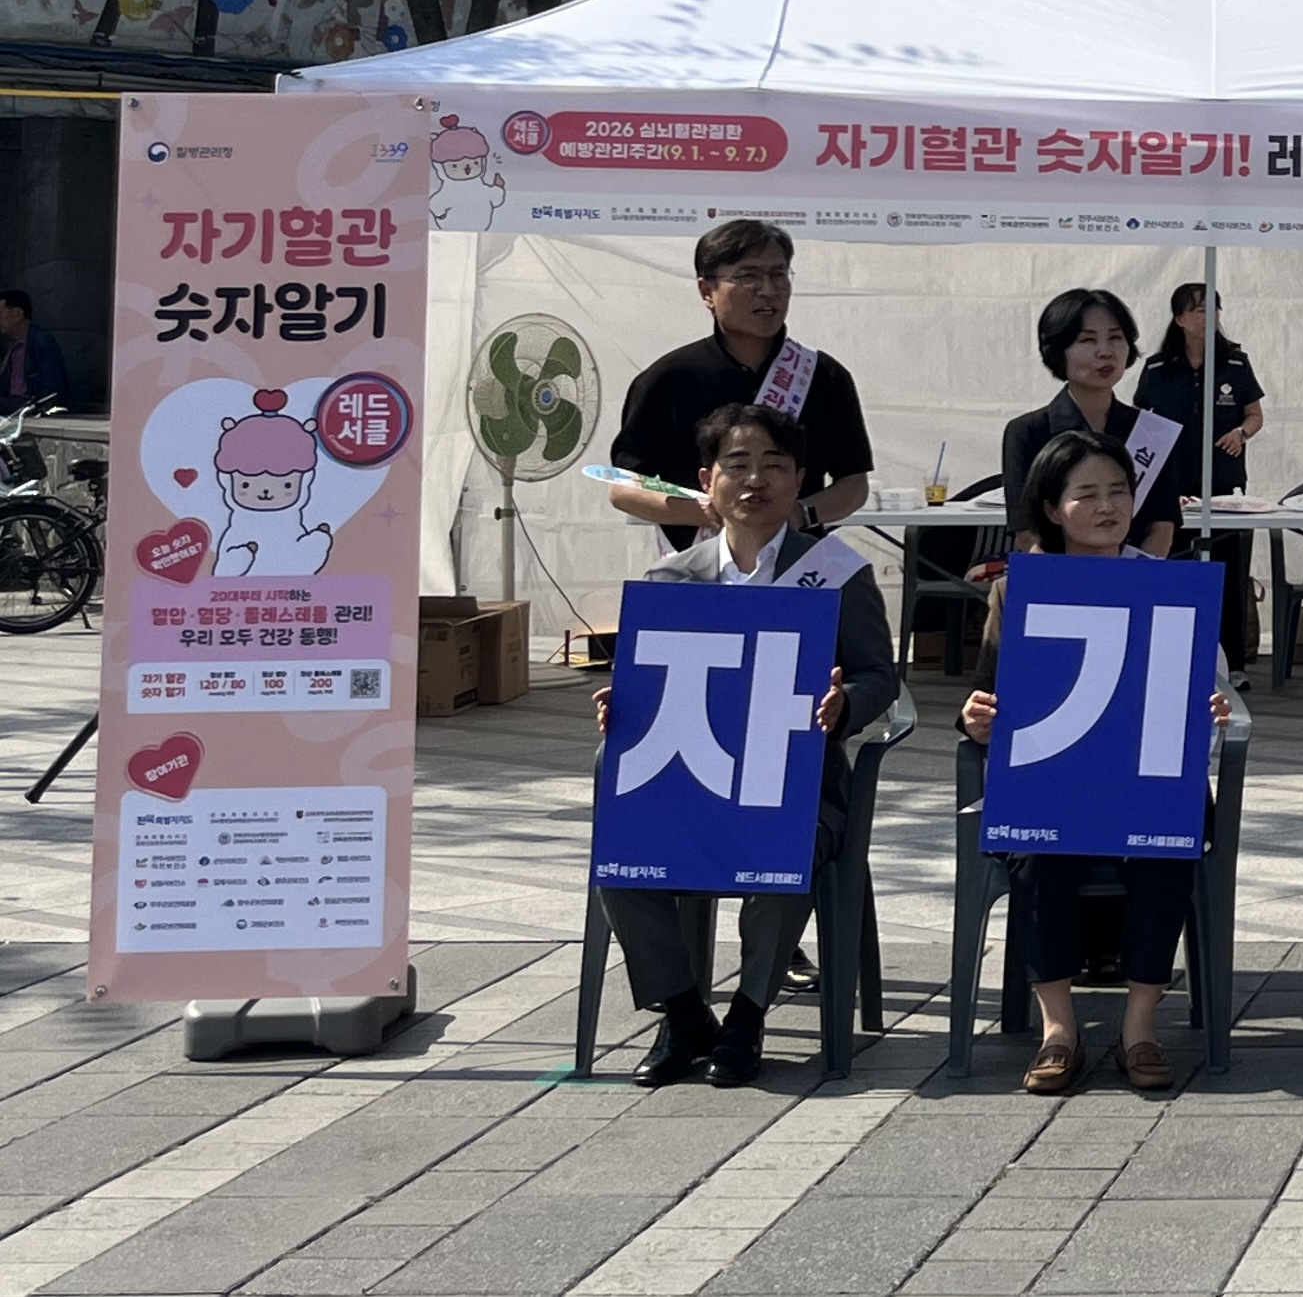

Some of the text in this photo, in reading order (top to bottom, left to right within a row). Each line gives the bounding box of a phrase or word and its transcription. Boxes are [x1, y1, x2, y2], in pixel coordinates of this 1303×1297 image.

[585, 121, 743, 141] 2026 심뇌혈관질환
[815, 123, 1022, 174] 자기혈관
[1036, 128, 1252, 178] 숫자알기!
[160, 206, 397, 266] 자기혈관
[154, 282, 386, 342] 숫자알기
[338, 393, 390, 418] 레드
[337, 420, 390, 445] 서클
[334, 606, 372, 623] 관리!
[180, 629, 212, 647] 우리
[219, 630, 253, 646] 모두
[259, 628, 294, 646] 건강
[309, 677, 333, 688] 200
[1010, 603, 1196, 778] 기
[616, 630, 815, 807] 자
